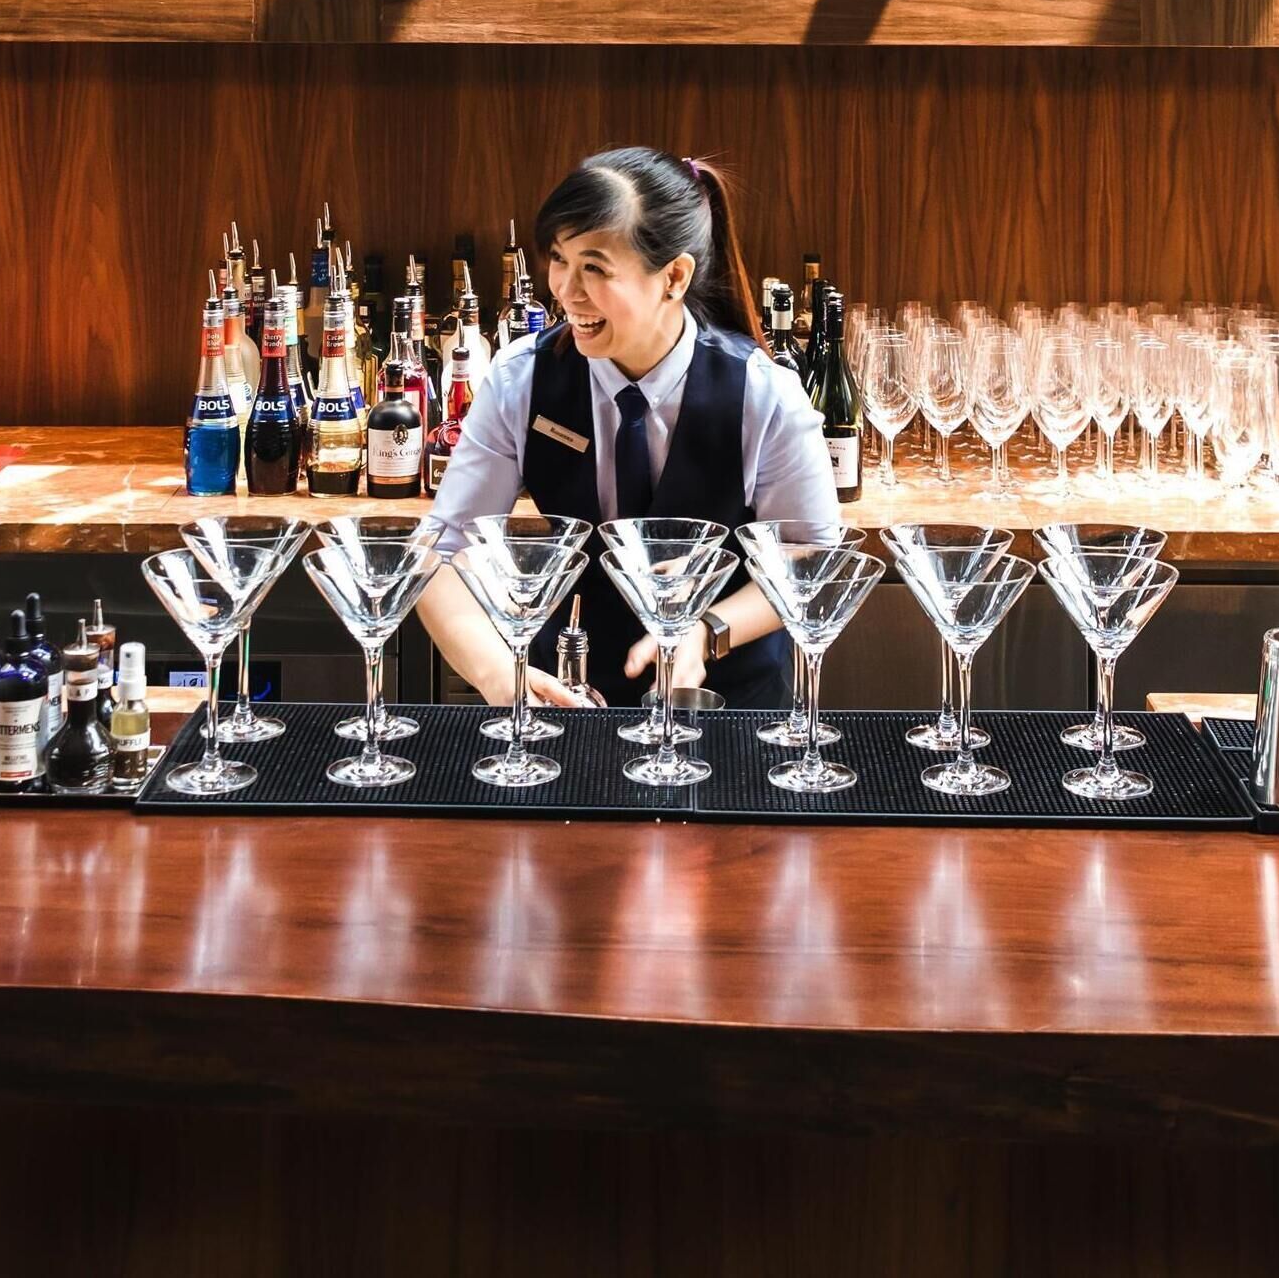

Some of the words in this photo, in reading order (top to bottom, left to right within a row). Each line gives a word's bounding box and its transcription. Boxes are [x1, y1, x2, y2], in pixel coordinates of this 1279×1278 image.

[263, 334, 282, 343] Cherry
[197, 401, 230, 411] BOLS
[254, 401, 286, 411] BOLS
[317, 402, 350, 413] BOLS
